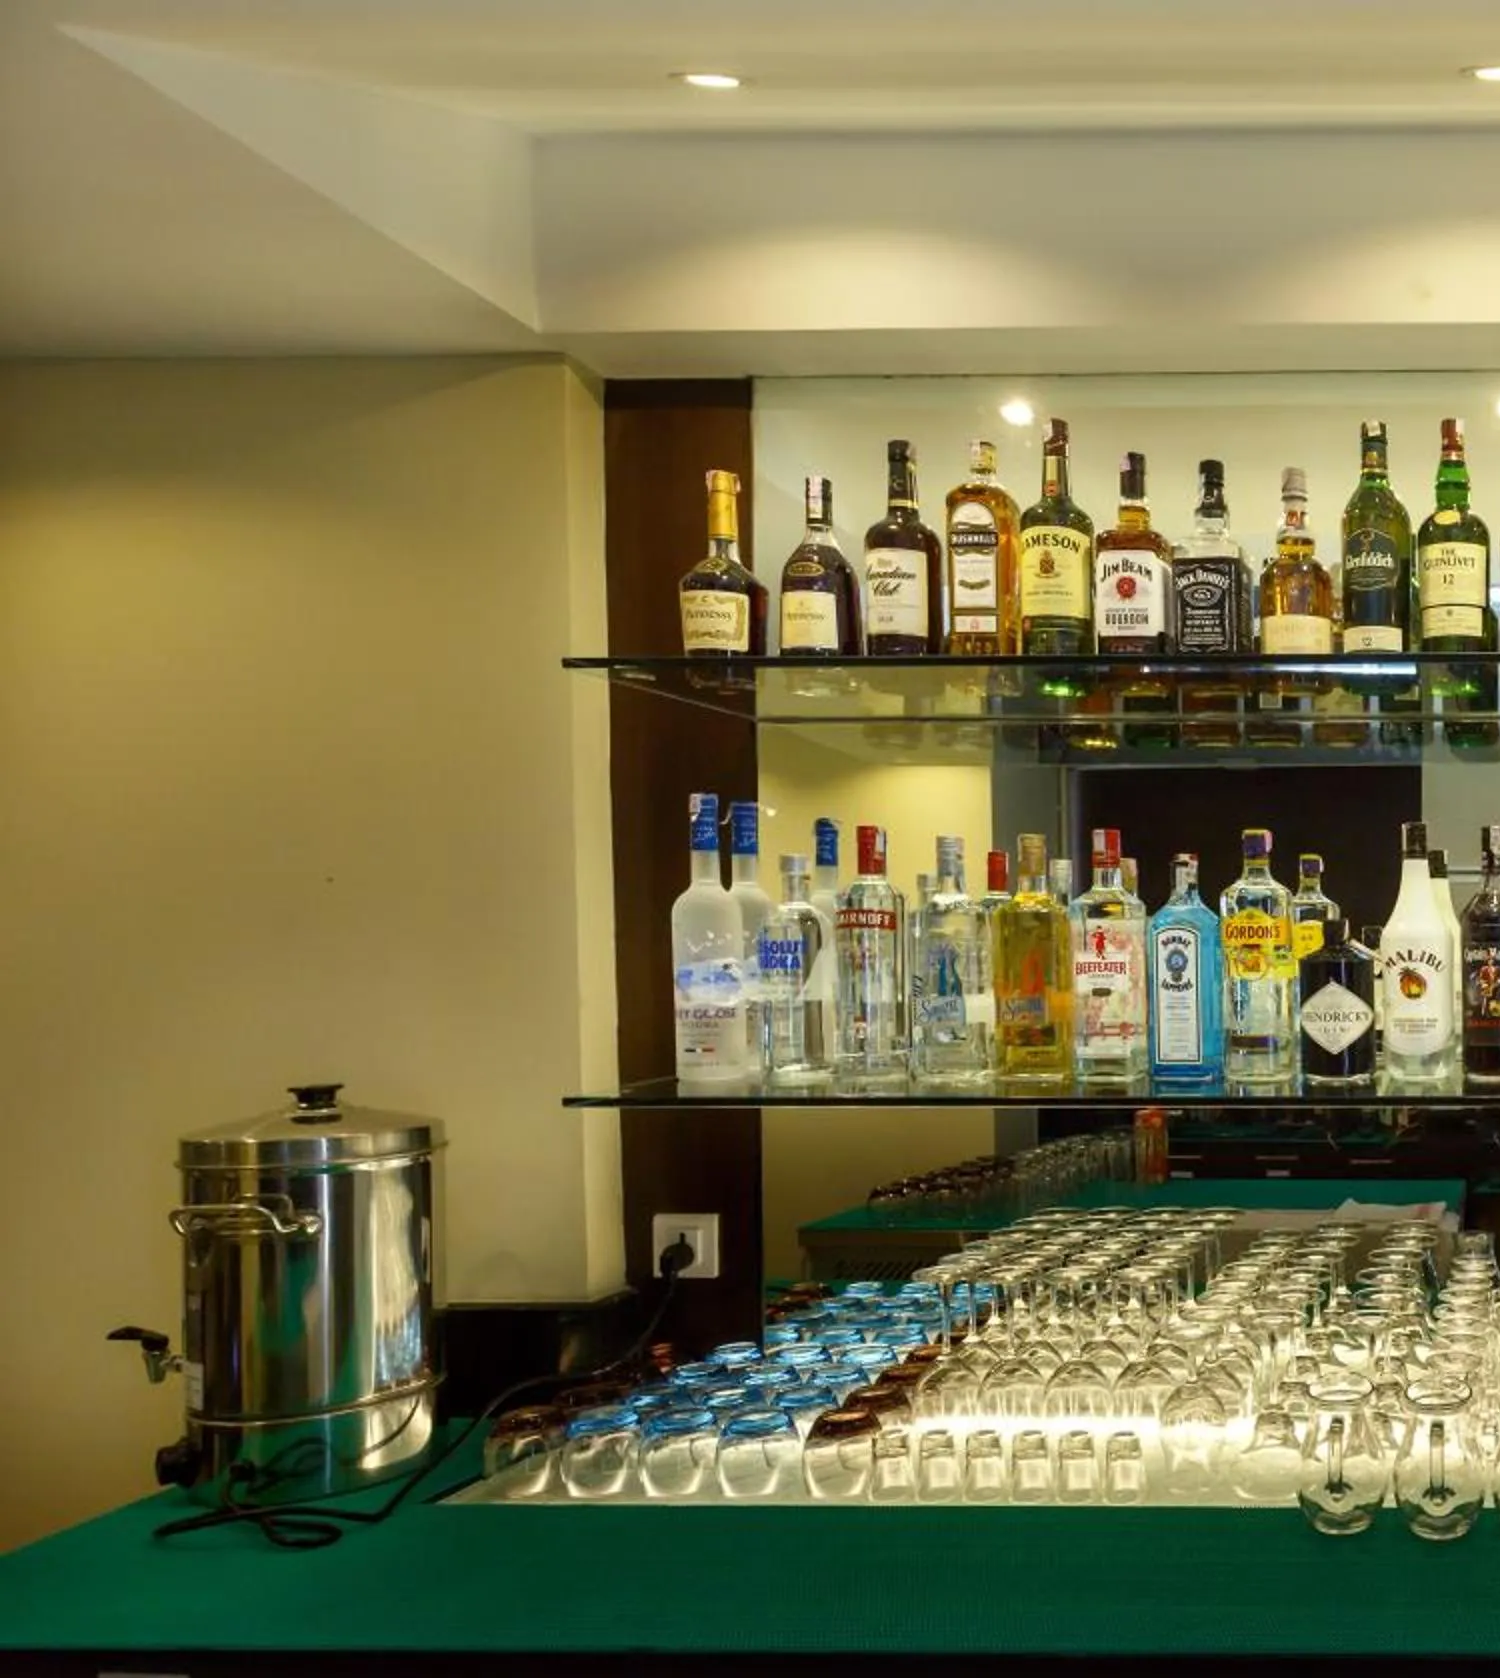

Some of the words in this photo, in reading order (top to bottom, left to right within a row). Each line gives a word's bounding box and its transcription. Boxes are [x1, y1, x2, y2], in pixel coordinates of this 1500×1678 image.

[1100, 562, 1120, 583] JIM
[1121, 557, 1154, 582] BEAM
[1423, 557, 1476, 569] GLENLIVET
[1441, 573, 1455, 585] 12
[1225, 924, 1281, 940] GORDON'S
[1075, 961, 1127, 975] BEEFEATER
[1385, 948, 1447, 973] MALIBU
